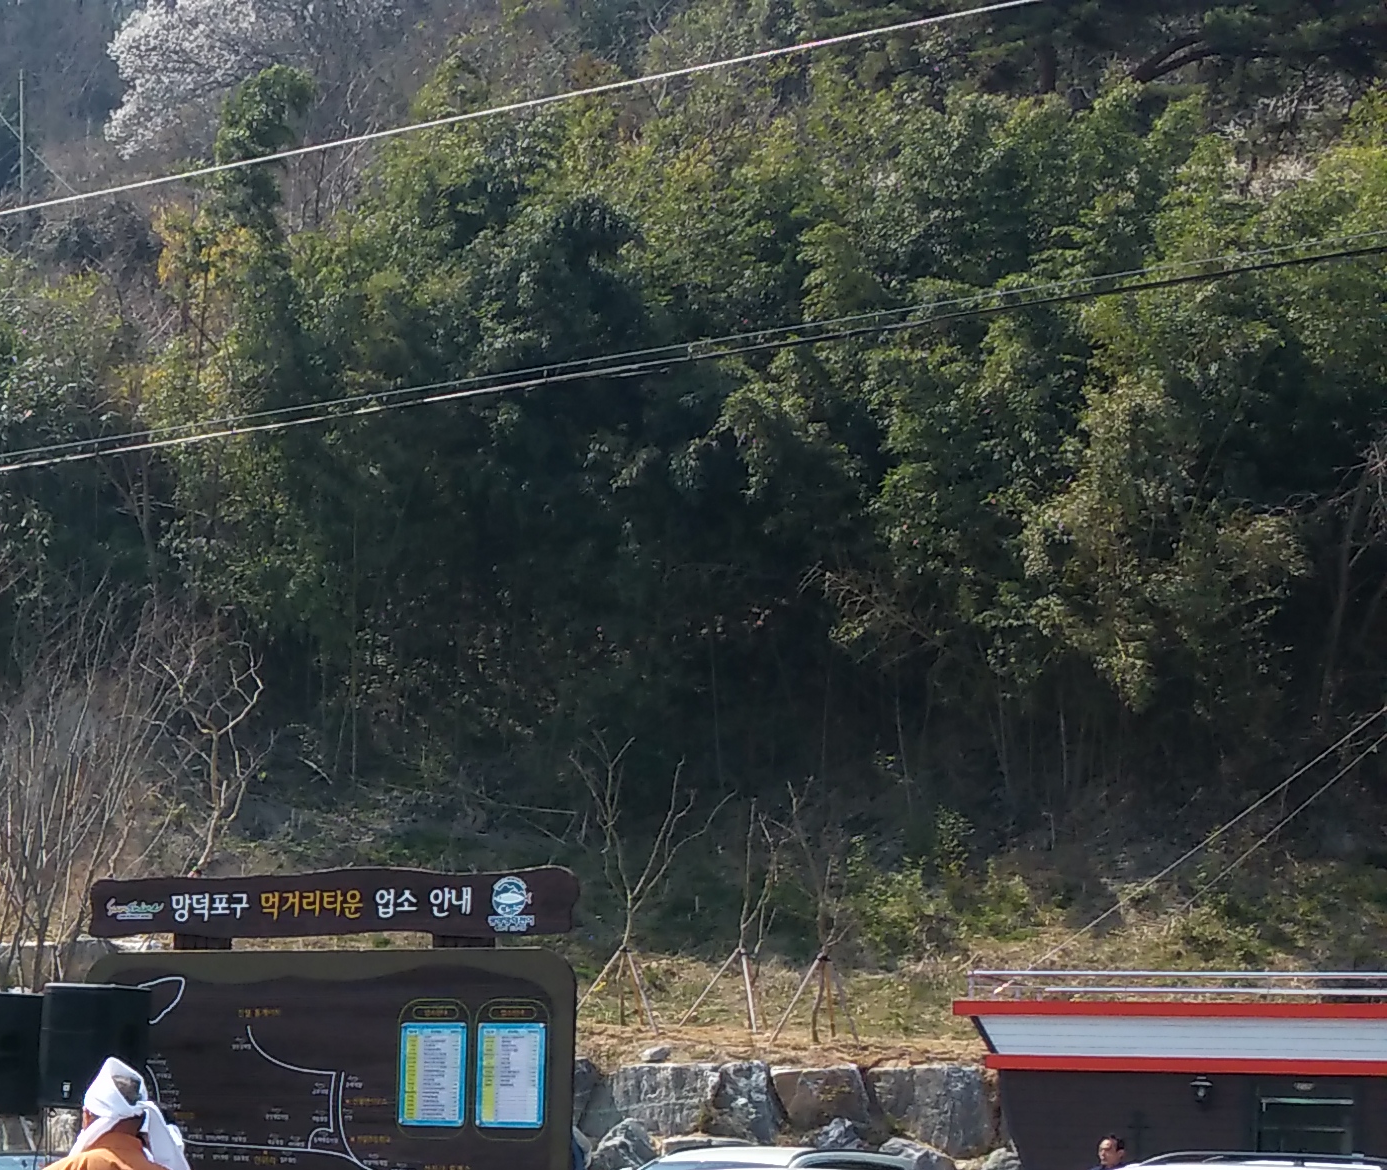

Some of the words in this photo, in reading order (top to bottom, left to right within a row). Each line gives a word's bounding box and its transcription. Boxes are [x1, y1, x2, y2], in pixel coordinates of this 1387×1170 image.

[170, 892, 250, 922] 망덕포구
[260, 888, 364, 920] 먹거리타운
[375, 887, 419, 919] 업소
[429, 886, 473, 917] 안내
